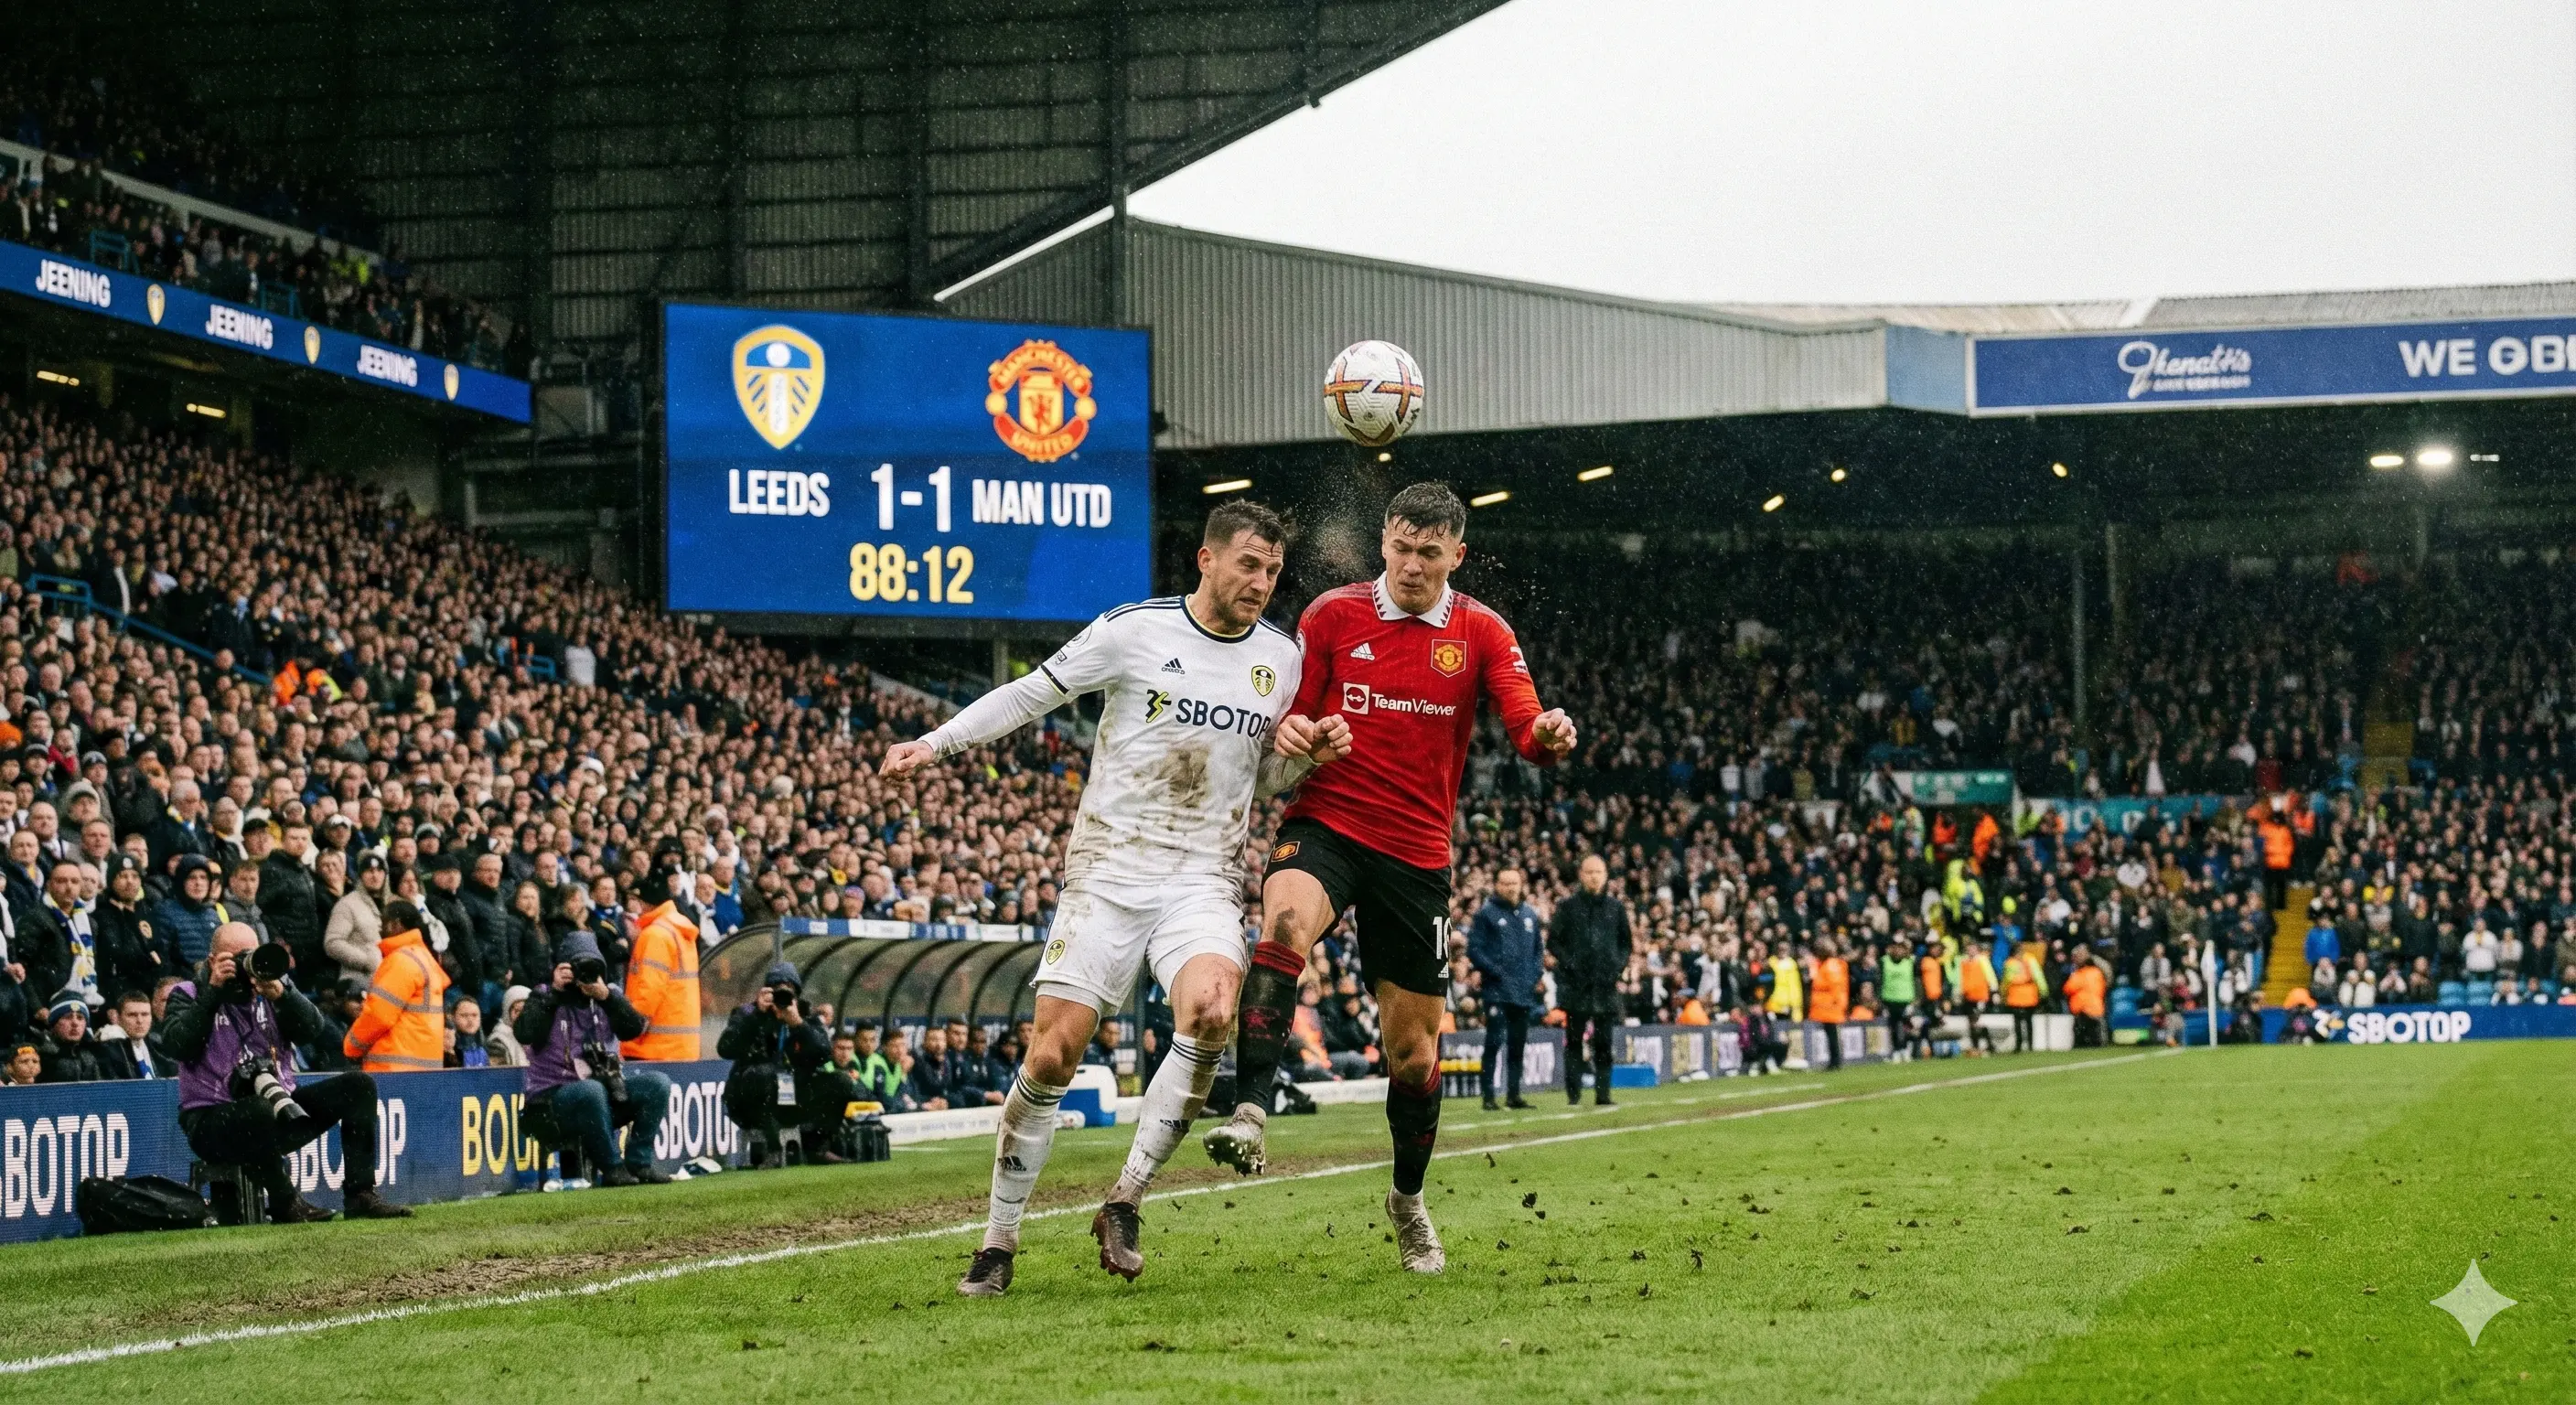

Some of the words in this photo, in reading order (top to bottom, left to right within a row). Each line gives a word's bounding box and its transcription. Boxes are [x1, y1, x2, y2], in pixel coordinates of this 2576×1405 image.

[2398, 338, 2477, 378] WE
[729, 469, 830, 517] LEEDS
[871, 463, 951, 532] 1-1
[972, 478, 1045, 525] MAN
[1051, 482, 1111, 528] UTD
[850, 542, 974, 604] 88:12
[1175, 698, 1272, 740] SBOTOP
[1372, 693, 1456, 716] TeamViewer
[2347, 1011, 2472, 1044] SBOTOP
[0, 1113, 130, 1217] BOTOP
